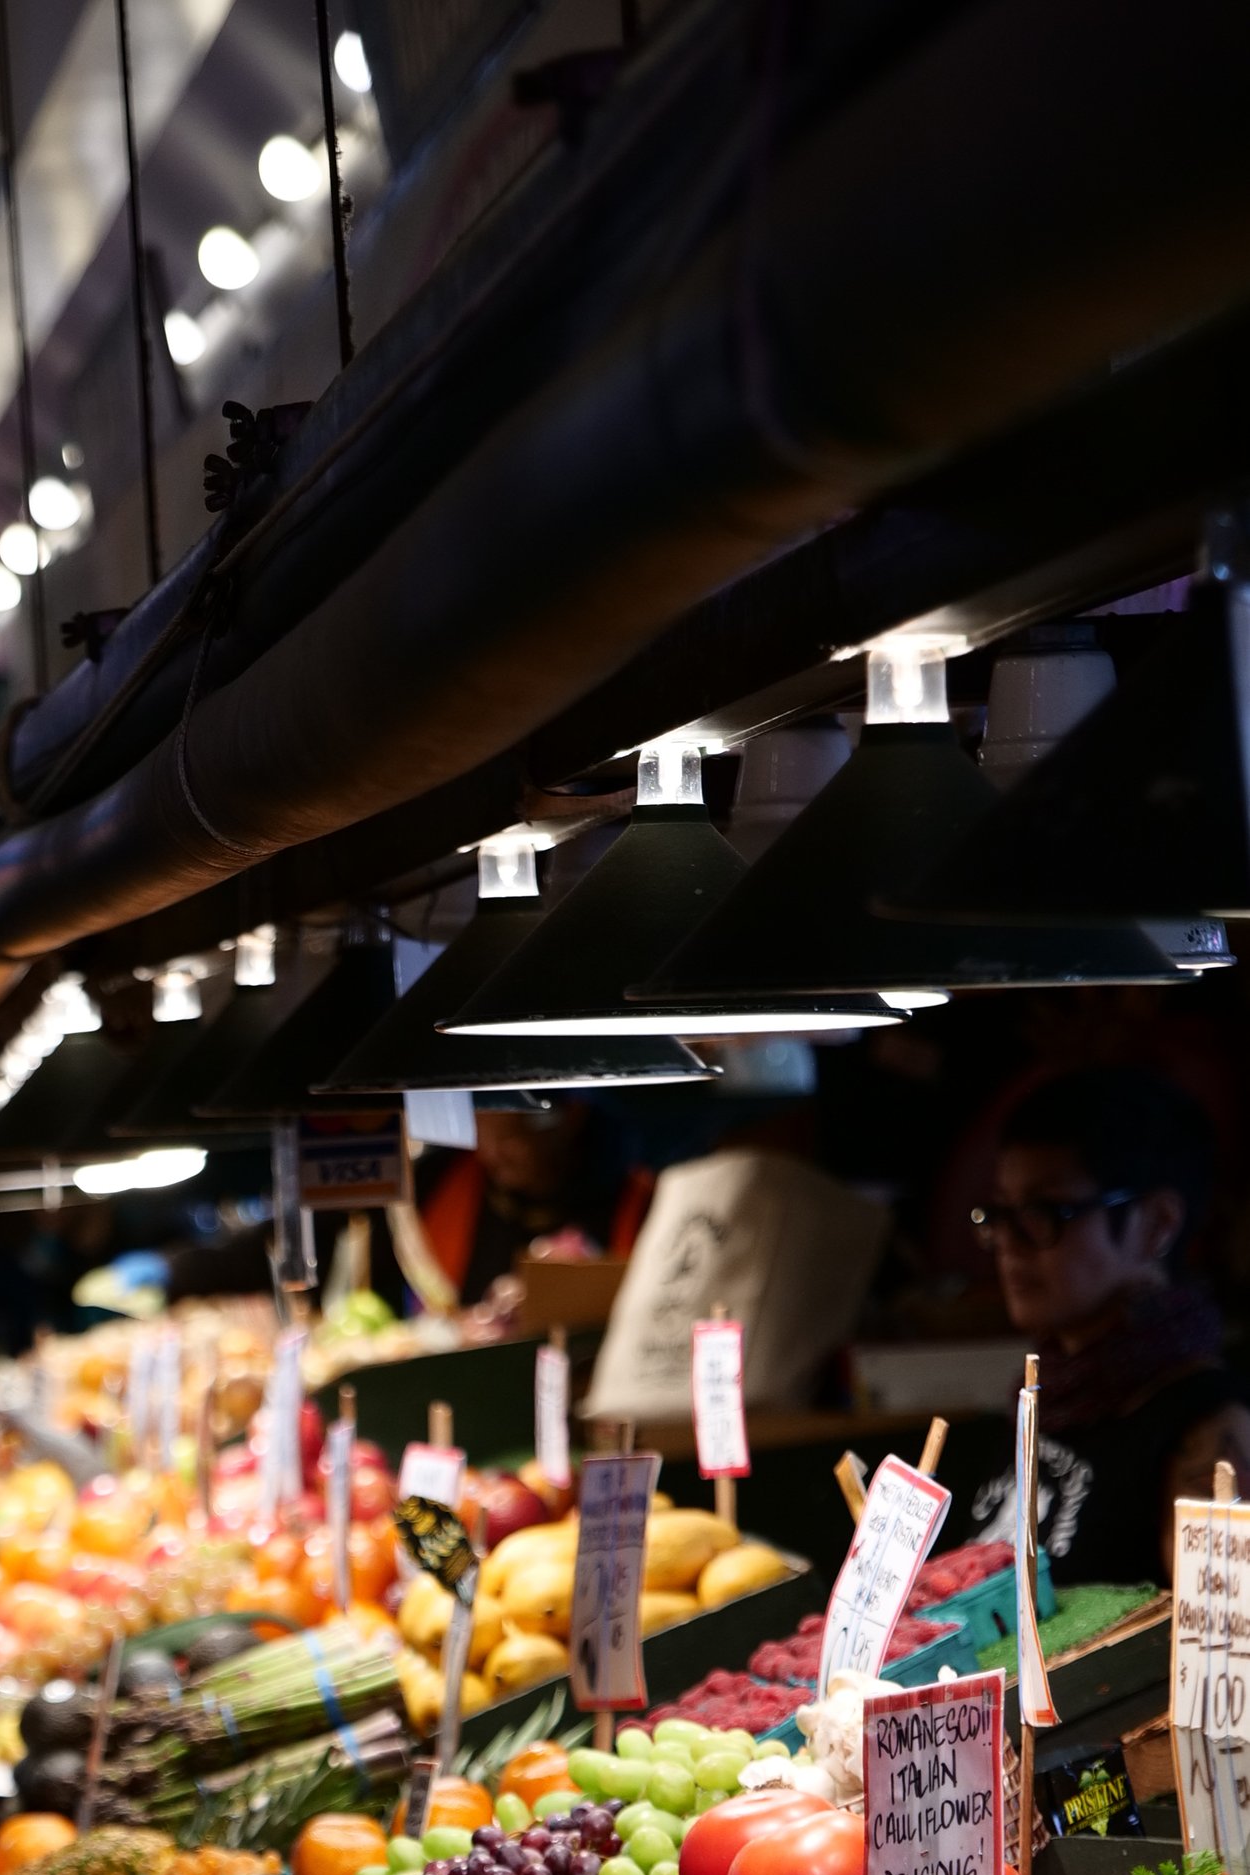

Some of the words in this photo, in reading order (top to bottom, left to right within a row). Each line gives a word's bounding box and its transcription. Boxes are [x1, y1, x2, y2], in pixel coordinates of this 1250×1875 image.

[319, 1160, 381, 1184] VISA
[876, 1703, 992, 1759] ROMANESCO!!
[890, 1749, 957, 1805] ITALIAN
[1063, 1775, 1127, 1825] PRISTINE
[873, 1789, 993, 1850] CAULIFLOWER
